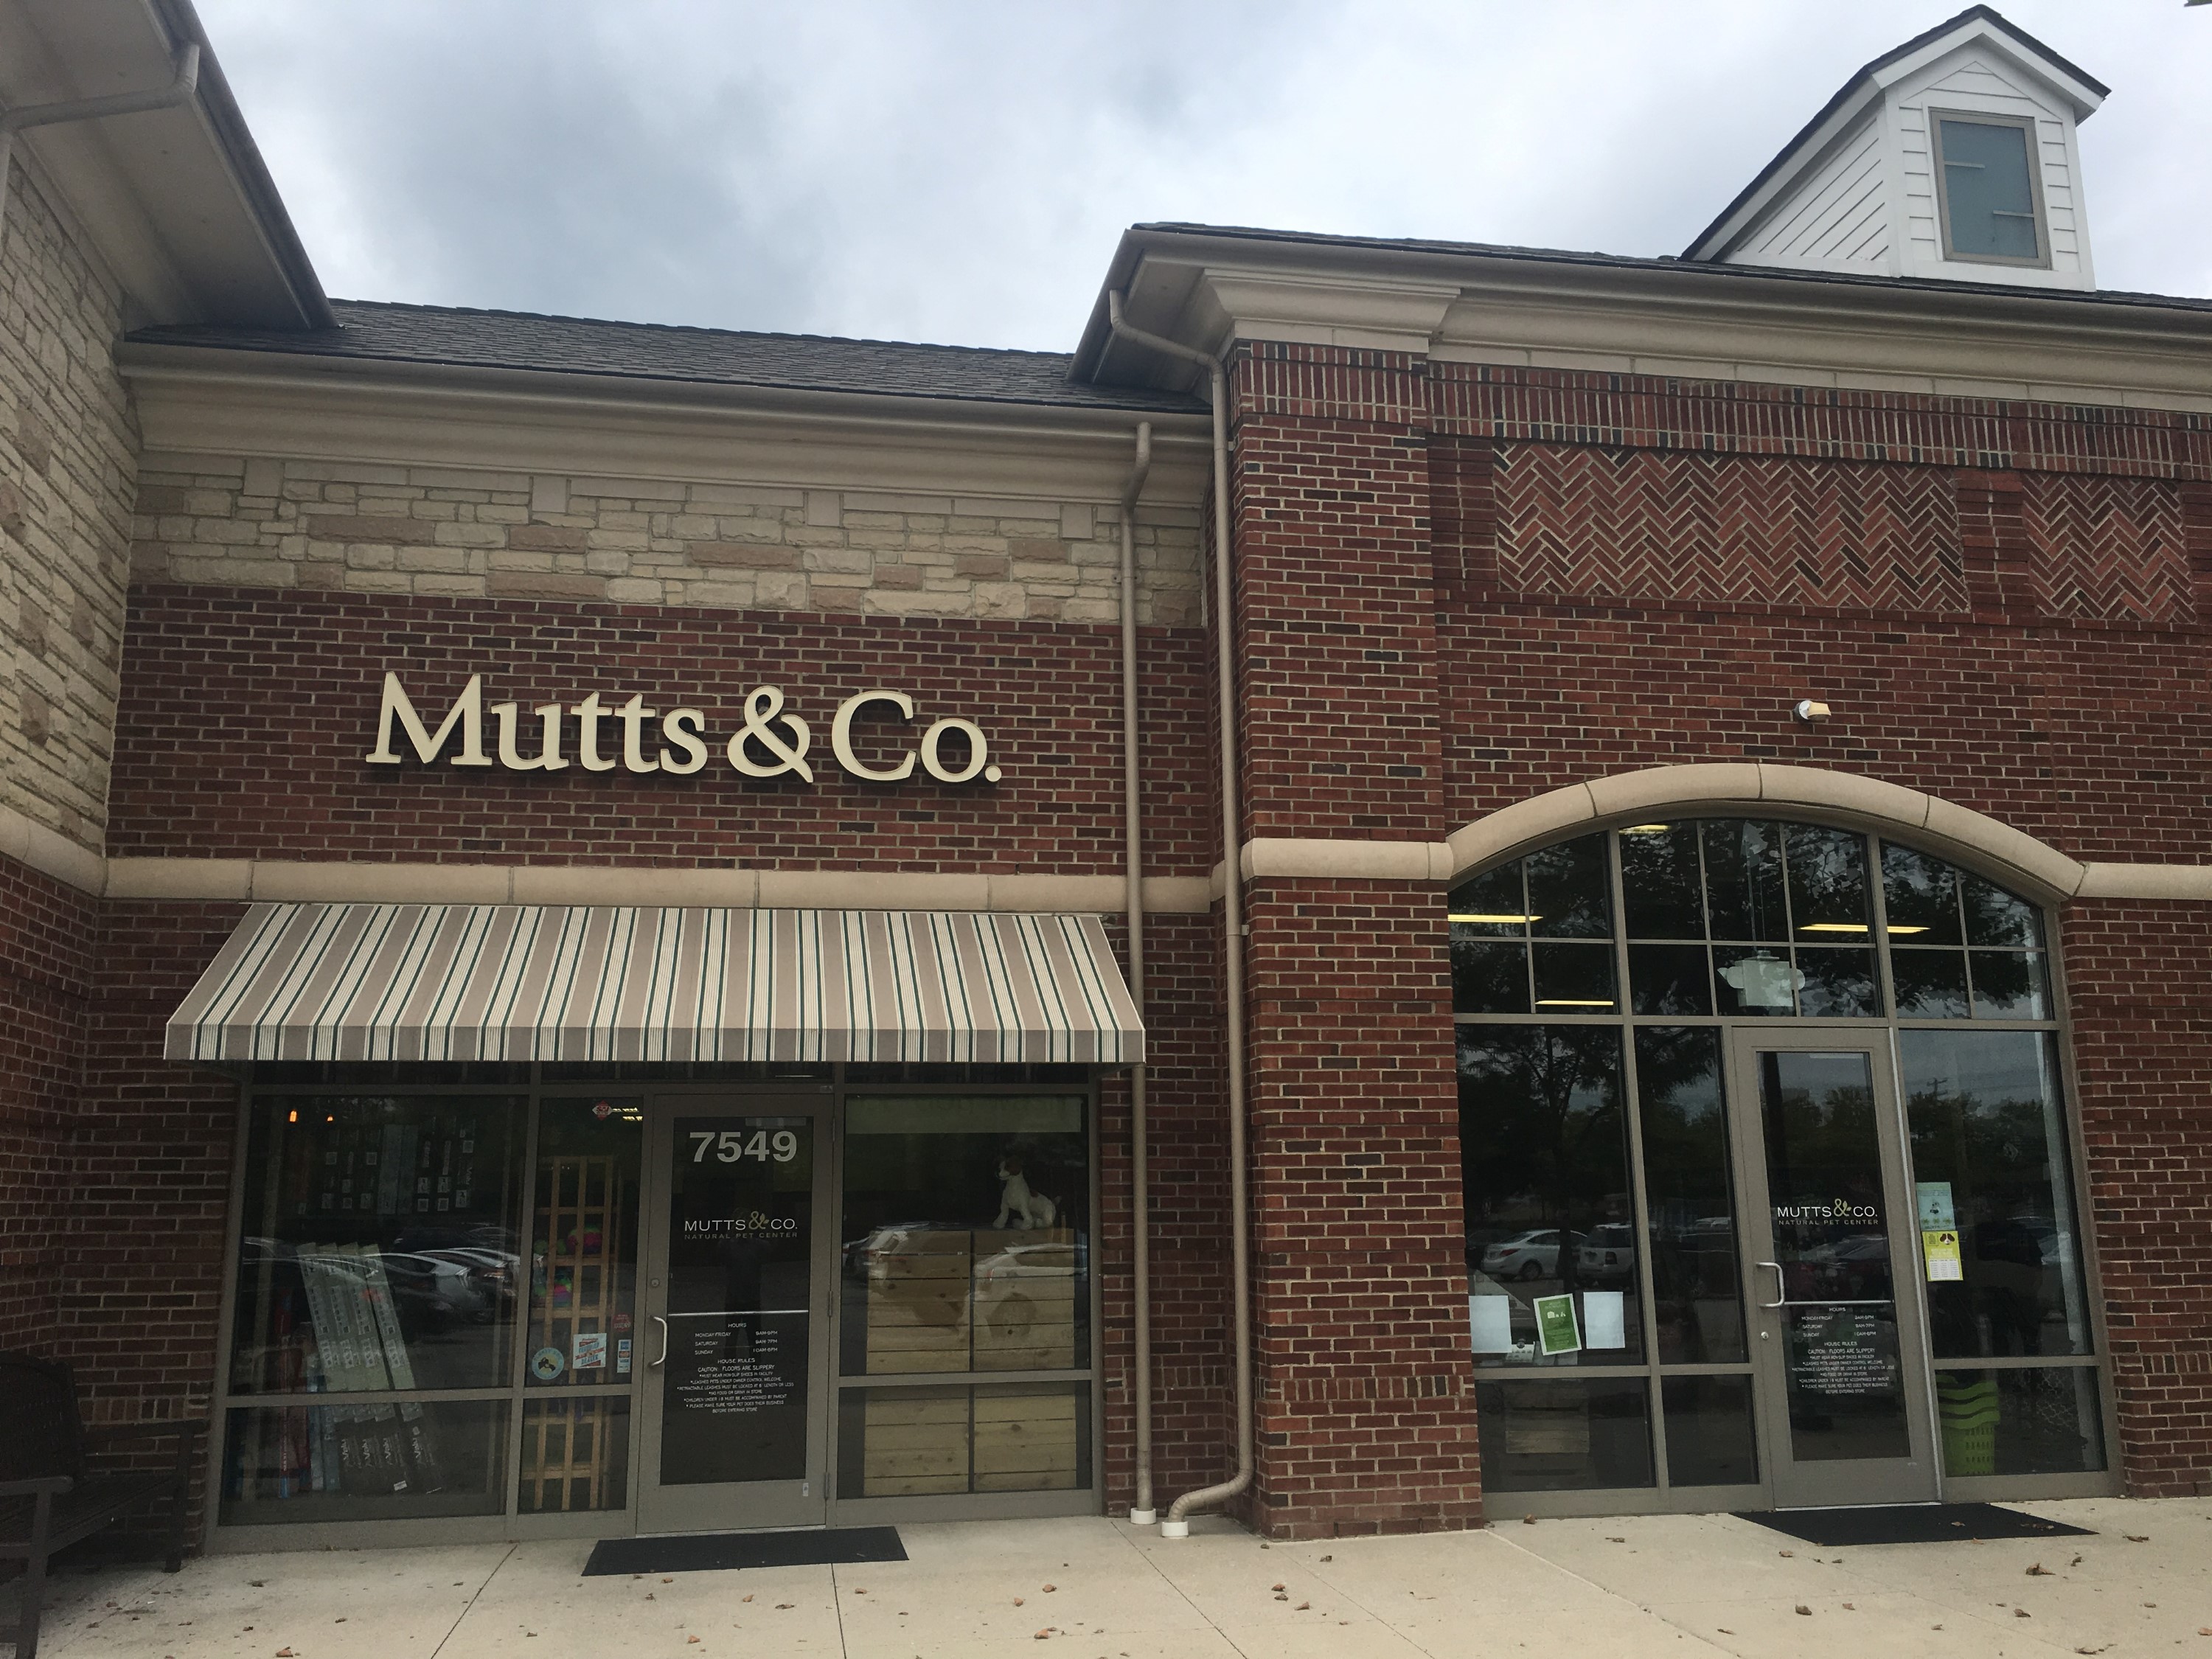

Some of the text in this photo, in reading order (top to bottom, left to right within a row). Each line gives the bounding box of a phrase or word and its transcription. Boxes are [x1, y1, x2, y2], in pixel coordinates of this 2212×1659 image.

[366, 670, 1003, 783] Mutts & Co.
[689, 1130, 798, 1163] 7549
